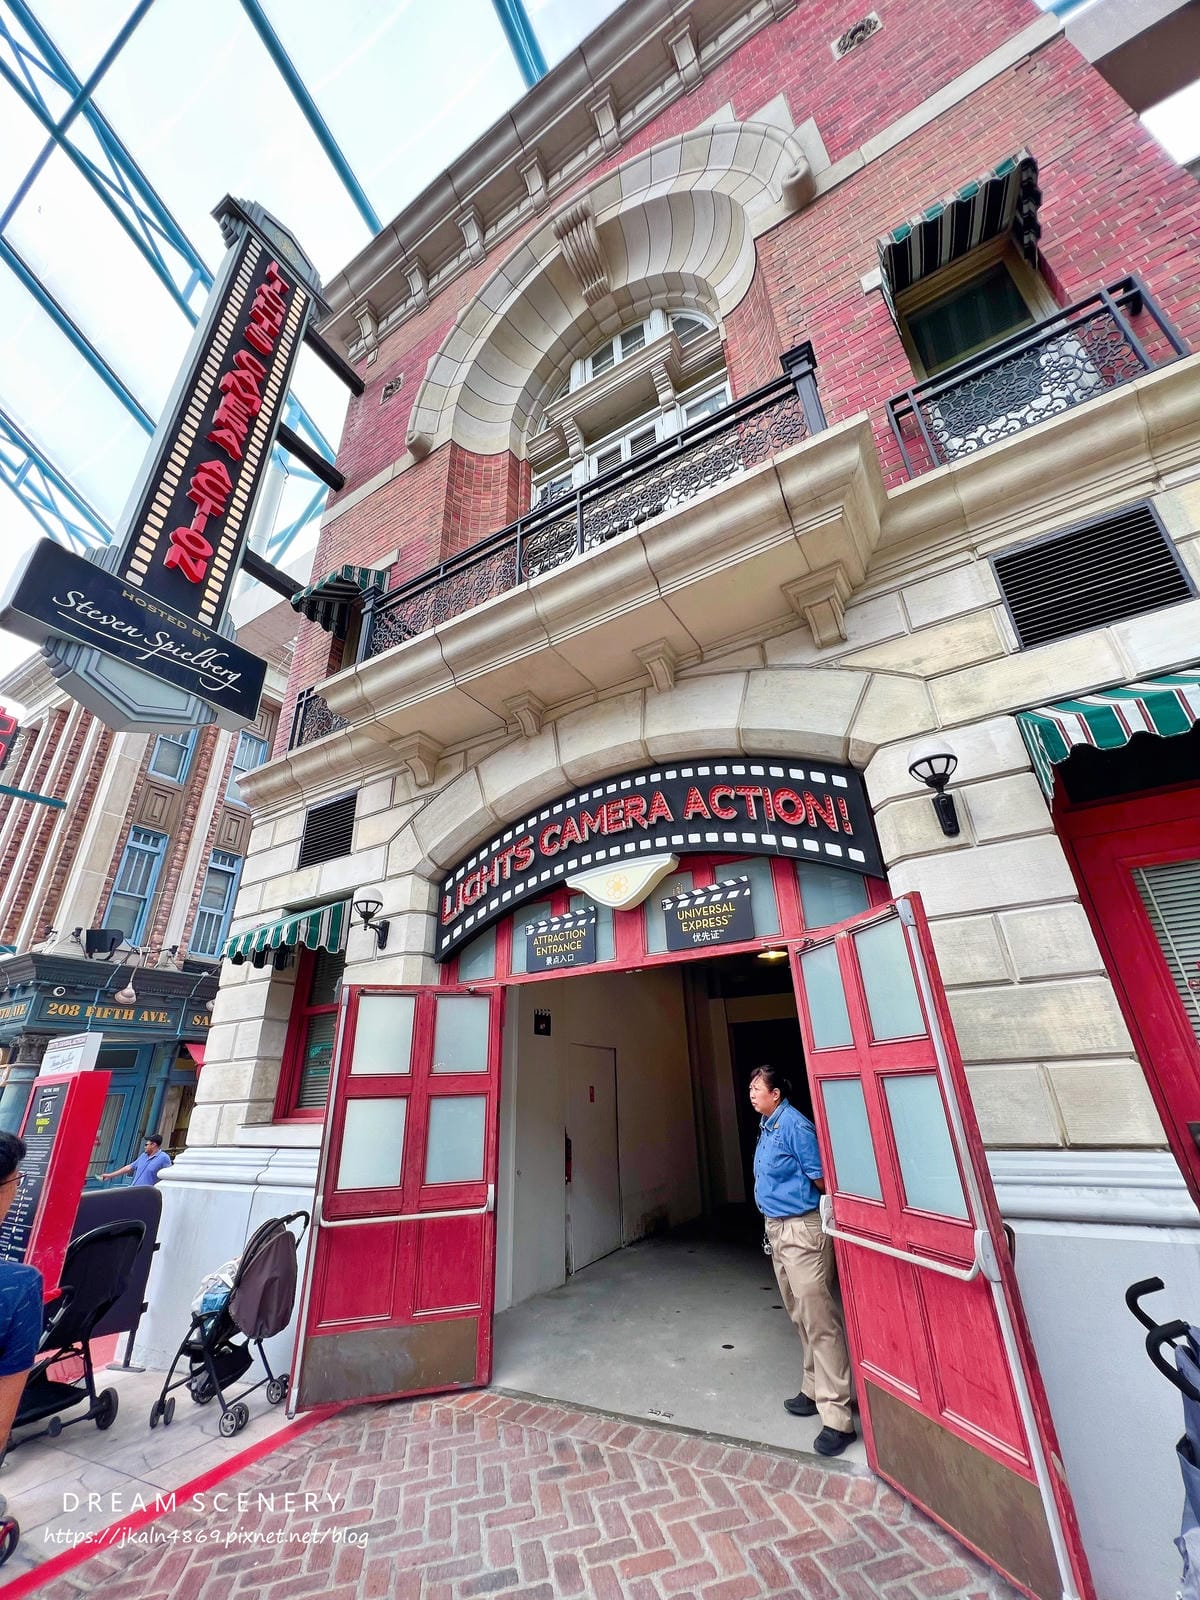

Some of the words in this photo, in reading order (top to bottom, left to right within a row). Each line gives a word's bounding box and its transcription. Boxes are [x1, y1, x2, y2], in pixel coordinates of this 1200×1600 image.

[243, 260, 290, 356] LIGHTS
[205, 350, 267, 462] CAMERA
[163, 459, 233, 584] ACTION
[52, 590, 143, 638] Steven
[136, 631, 242, 691] Spielberg
[122, 589, 188, 630] HOSTED
[191, 627, 211, 642] BY
[442, 834, 535, 926] LIGHTS
[538, 790, 674, 856] CAMERA
[683, 784, 854, 836] ACTION!
[533, 928, 586, 946] ATTRACTION
[536, 940, 583, 956] ENTRANCE
[677, 902, 736, 920] UNIVERSAL
[47, 1002, 81, 1016] 208
[85, 1005, 134, 1020] FIFTH
[139, 1010, 171, 1023] AVE.
